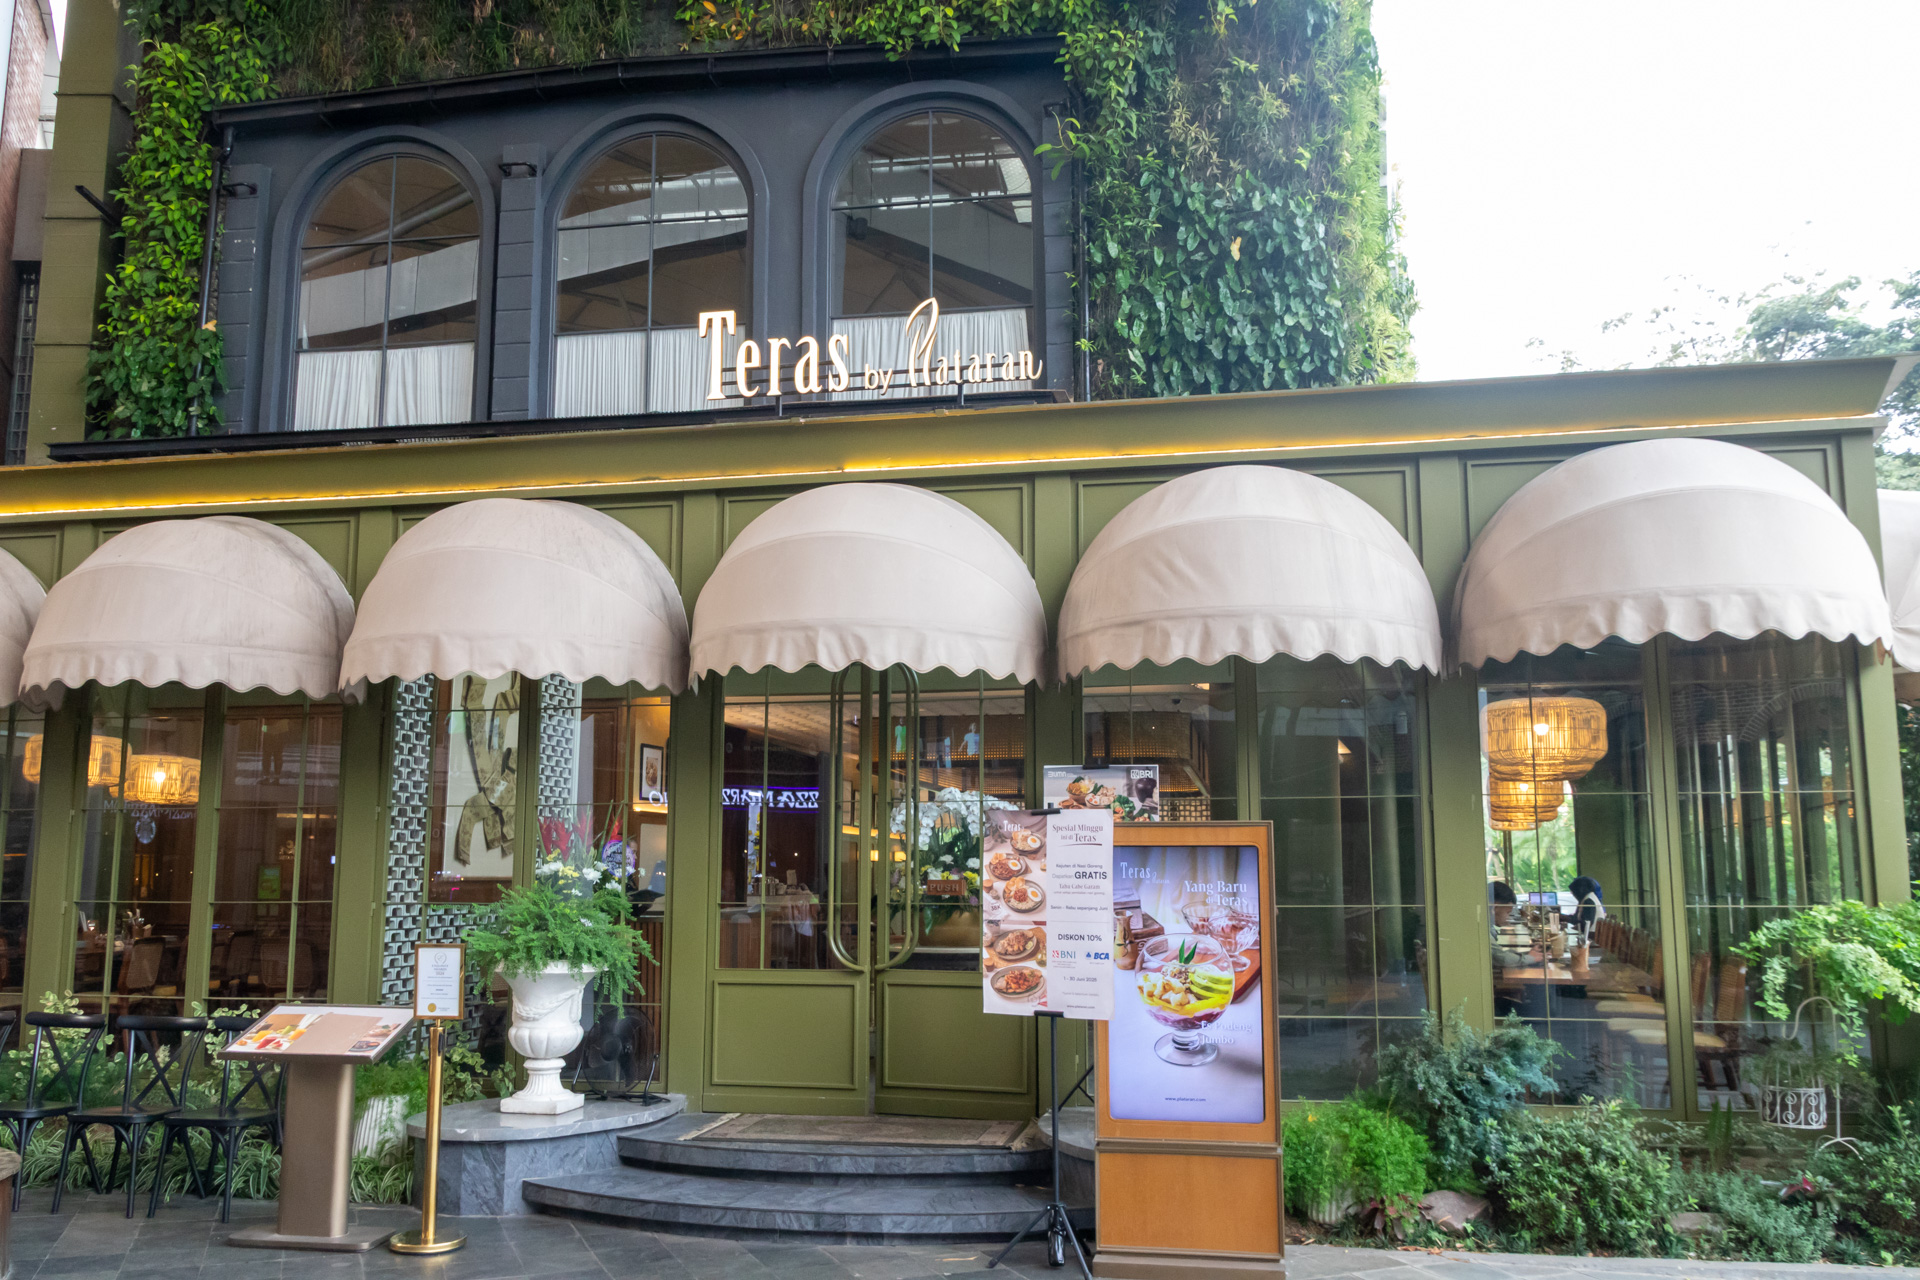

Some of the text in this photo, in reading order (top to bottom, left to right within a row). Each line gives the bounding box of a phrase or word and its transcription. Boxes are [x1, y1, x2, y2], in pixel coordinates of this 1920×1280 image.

[698, 310, 850, 401] Teras
[863, 363, 893, 396] by
[1139, 770, 1153, 778] BRI
[1003, 820, 1021, 832] Teras
[1052, 824, 1104, 833] Spesial Minggu
[1074, 833, 1097, 842] Teras
[1120, 861, 1151, 879] Teras
[1074, 871, 1108, 880] GRATIS
[930, 884, 959, 892] PUSH
[1184, 880, 1247, 895] Yang Baru
[1206, 895, 1248, 906] di Teras
[1057, 933, 1102, 942] DISKON 10%
[1060, 950, 1076, 959] BNI
[1093, 952, 1110, 960] BCA
[1201, 1020, 1253, 1033] Es Podeng
[1200, 1034, 1235, 1045] Jumbo
